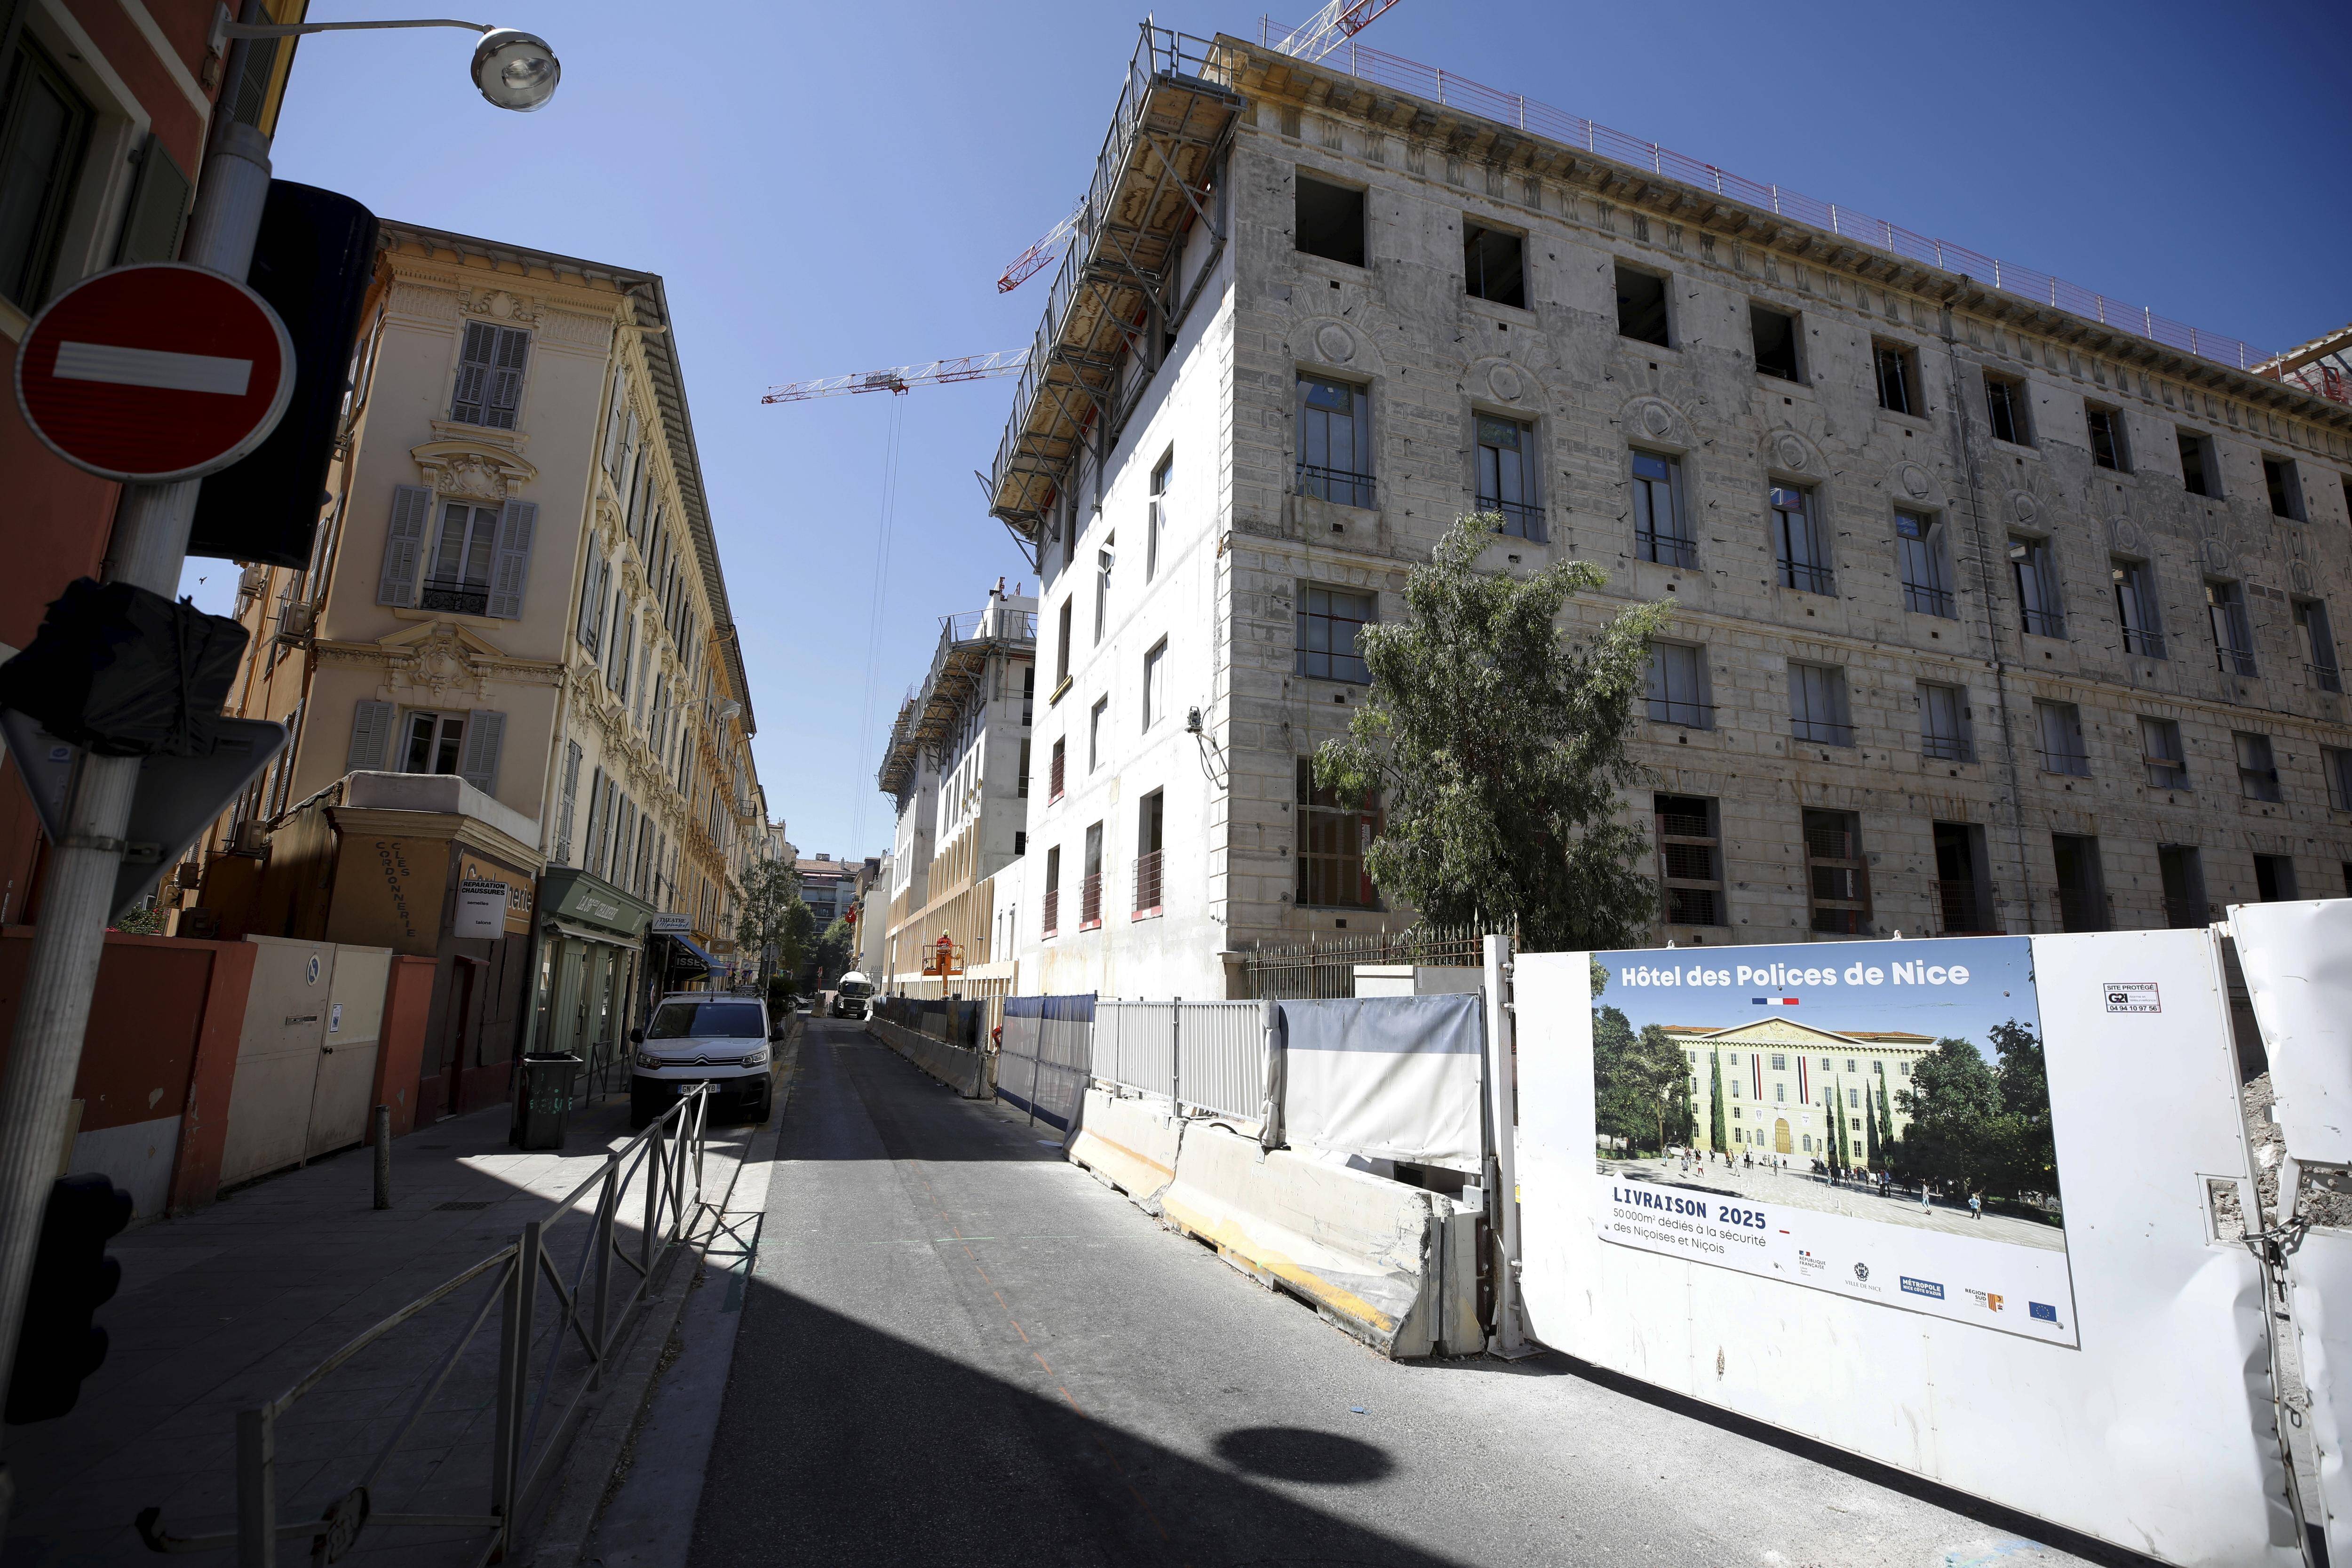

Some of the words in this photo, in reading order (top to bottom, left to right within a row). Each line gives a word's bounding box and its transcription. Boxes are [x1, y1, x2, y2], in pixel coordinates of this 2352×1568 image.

[575, 895, 588, 911] LA
[594, 903, 619, 921] CHAMBRE
[1621, 965, 1681, 987] Hôtel
[1686, 965, 1731, 987] des
[1737, 963, 1837, 987] Polices
[1843, 962, 1884, 986] de
[1891, 959, 1970, 986] Nice
[1614, 1186, 1707, 1218] LIVRAISON
[1719, 1206, 1766, 1229] 2025
[1614, 1222, 1631, 1234] des
[1634, 1226, 1676, 1243] Niçoises
[1678, 1236, 1689, 1246] et
[1692, 1237, 1725, 1254] Niçois
[1658, 1217, 1693, 1232] dédiés
[1696, 1224, 1703, 1234] à
[1707, 1226, 1716, 1237] la
[1720, 1229, 1766, 1247] sécurité
[1799, 1256, 1826, 1266] RÉPUBLIQUE
[1799, 1261, 1825, 1270] FRANÇAISE
[1902, 1279, 1941, 1292] MÉTROPOLE
